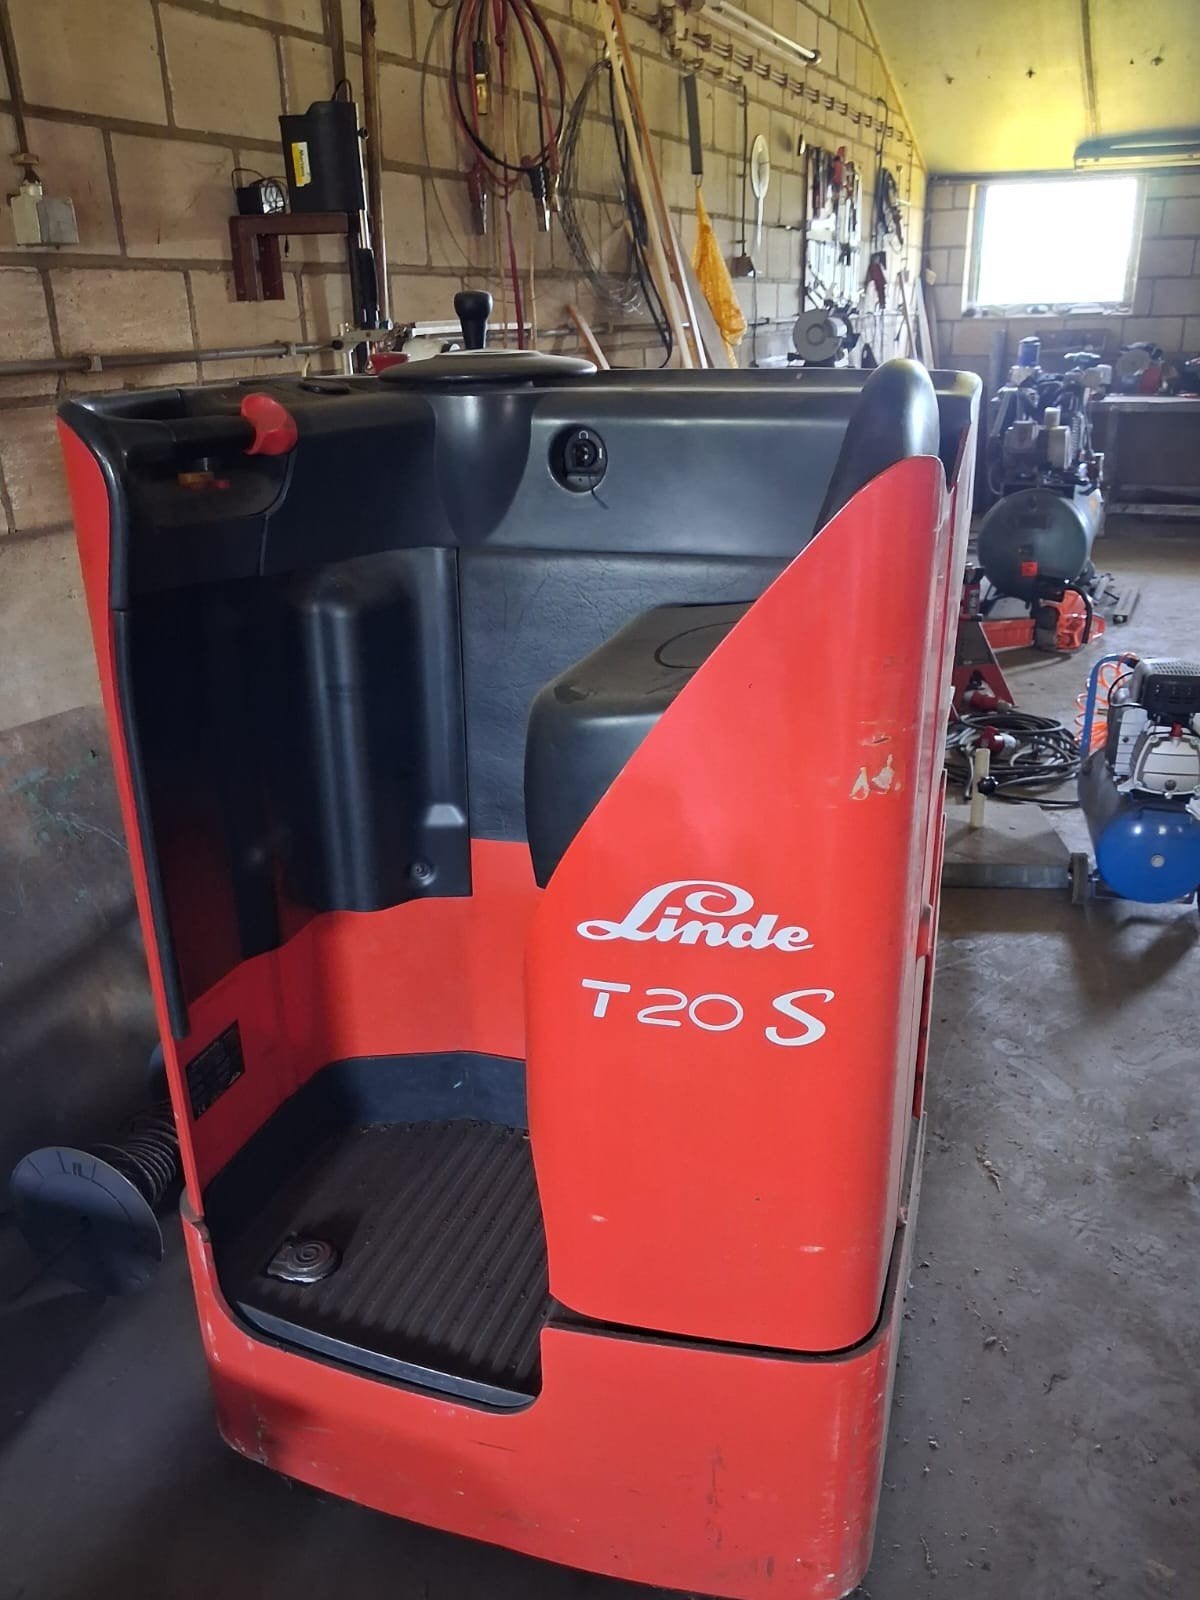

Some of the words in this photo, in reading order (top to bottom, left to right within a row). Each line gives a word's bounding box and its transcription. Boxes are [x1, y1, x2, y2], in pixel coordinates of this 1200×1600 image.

[576, 880, 814, 952] Linde
[582, 978, 631, 1018] T
[636, 988, 744, 1031] 20
[765, 988, 835, 1047] S
